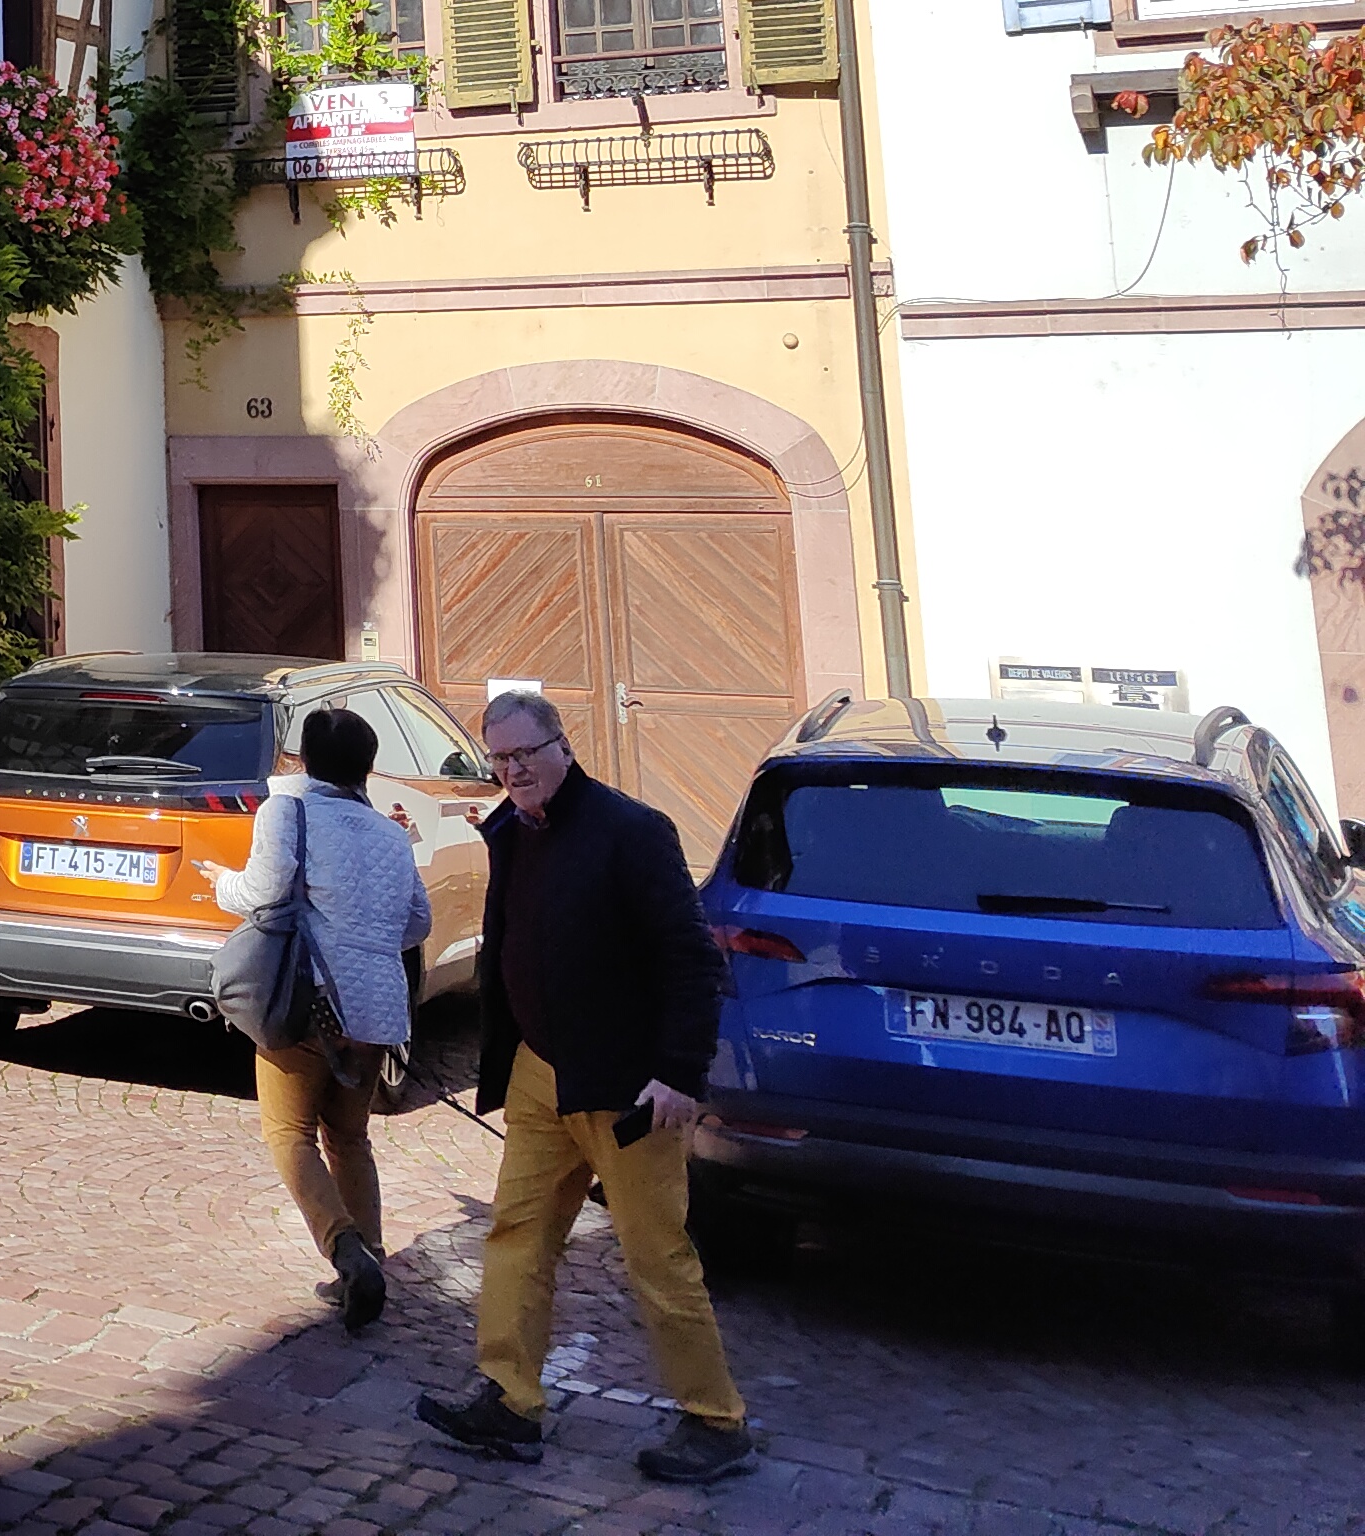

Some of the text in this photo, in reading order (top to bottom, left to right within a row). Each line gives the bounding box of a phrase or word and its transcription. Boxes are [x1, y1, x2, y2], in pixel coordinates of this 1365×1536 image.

[310, 91, 388, 111] VENS
[330, 126, 349, 138] 100
[246, 397, 273, 418] 63
[584, 474, 602, 488] 61
[1031, 669, 1041, 678] DE
[35, 846, 141, 878] FT-415-ZM
[144, 869, 156, 881] 68
[1095, 1035, 1113, 1050] 68
